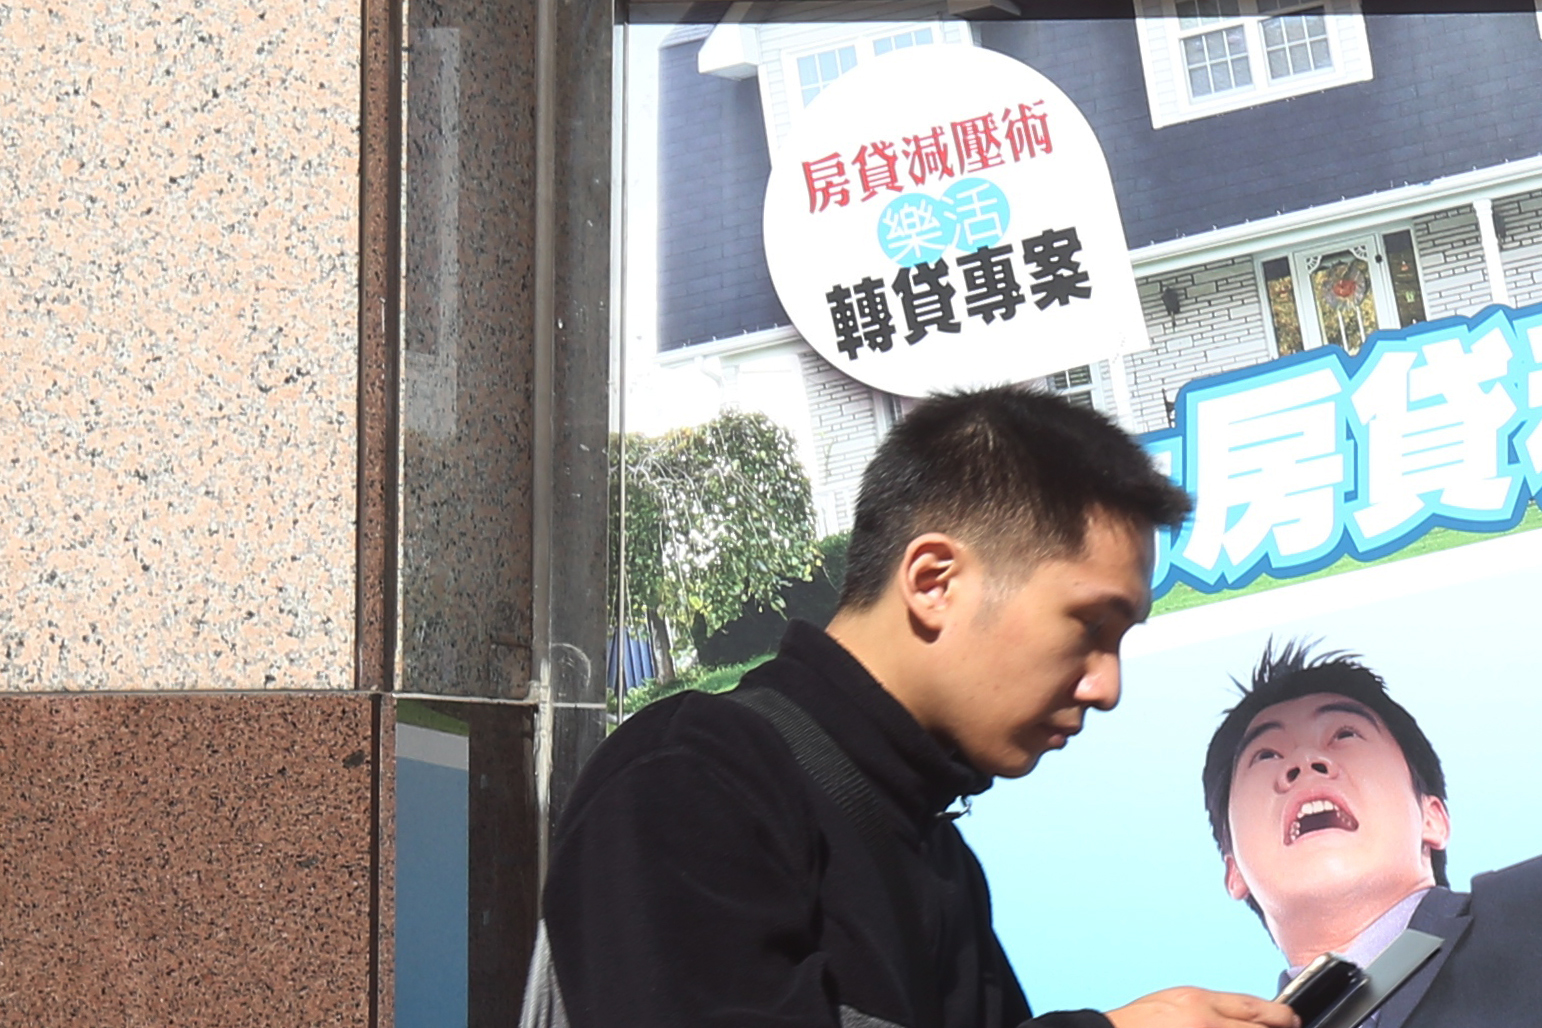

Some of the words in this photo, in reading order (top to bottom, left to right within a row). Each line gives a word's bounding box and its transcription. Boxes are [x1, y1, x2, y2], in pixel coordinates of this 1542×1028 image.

[802, 99, 1054, 214] 房貸減壓術
[882, 181, 1005, 262] 樂活
[825, 226, 1092, 361] 轉貸專案
